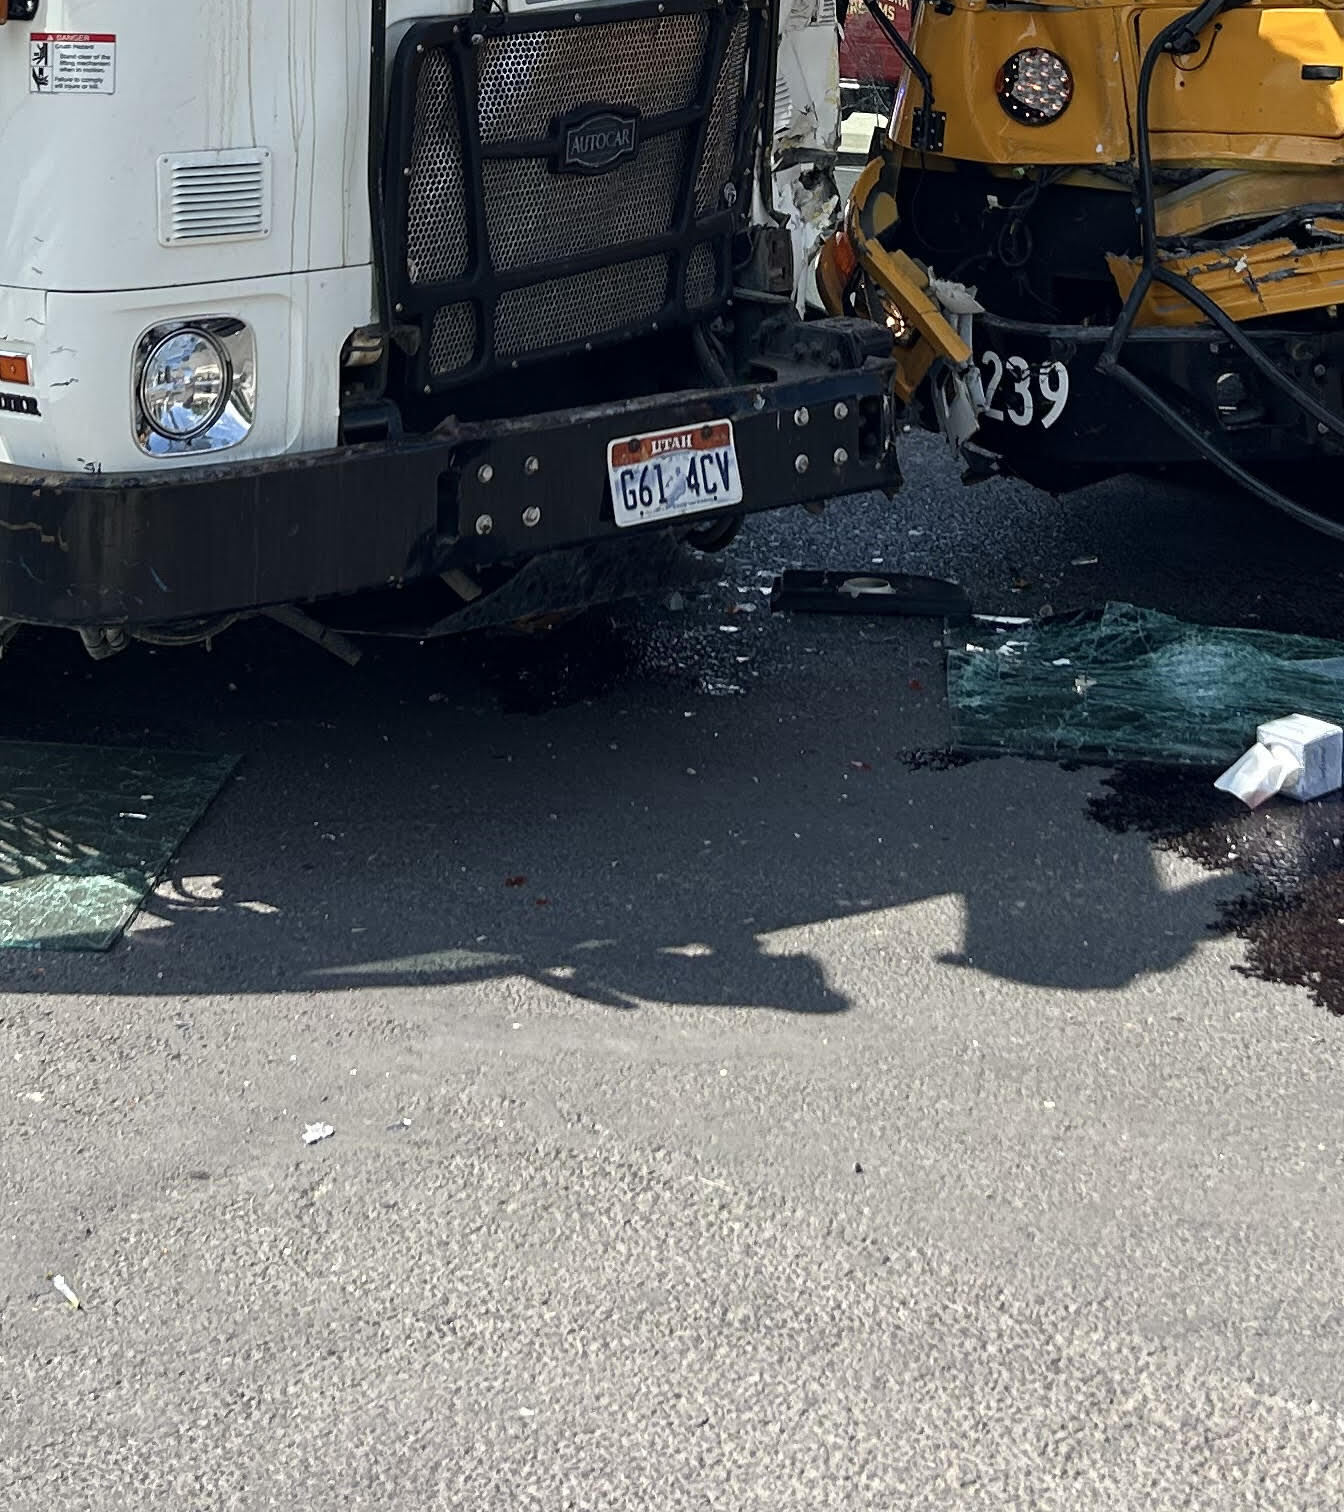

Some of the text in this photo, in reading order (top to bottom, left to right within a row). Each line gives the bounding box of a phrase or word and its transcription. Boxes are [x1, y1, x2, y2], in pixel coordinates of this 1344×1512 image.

[569, 128, 630, 156] AUTOCAR
[981, 350, 1069, 429] 239
[650, 433, 693, 455] UTAH
[686, 450, 730, 497] 4CV
